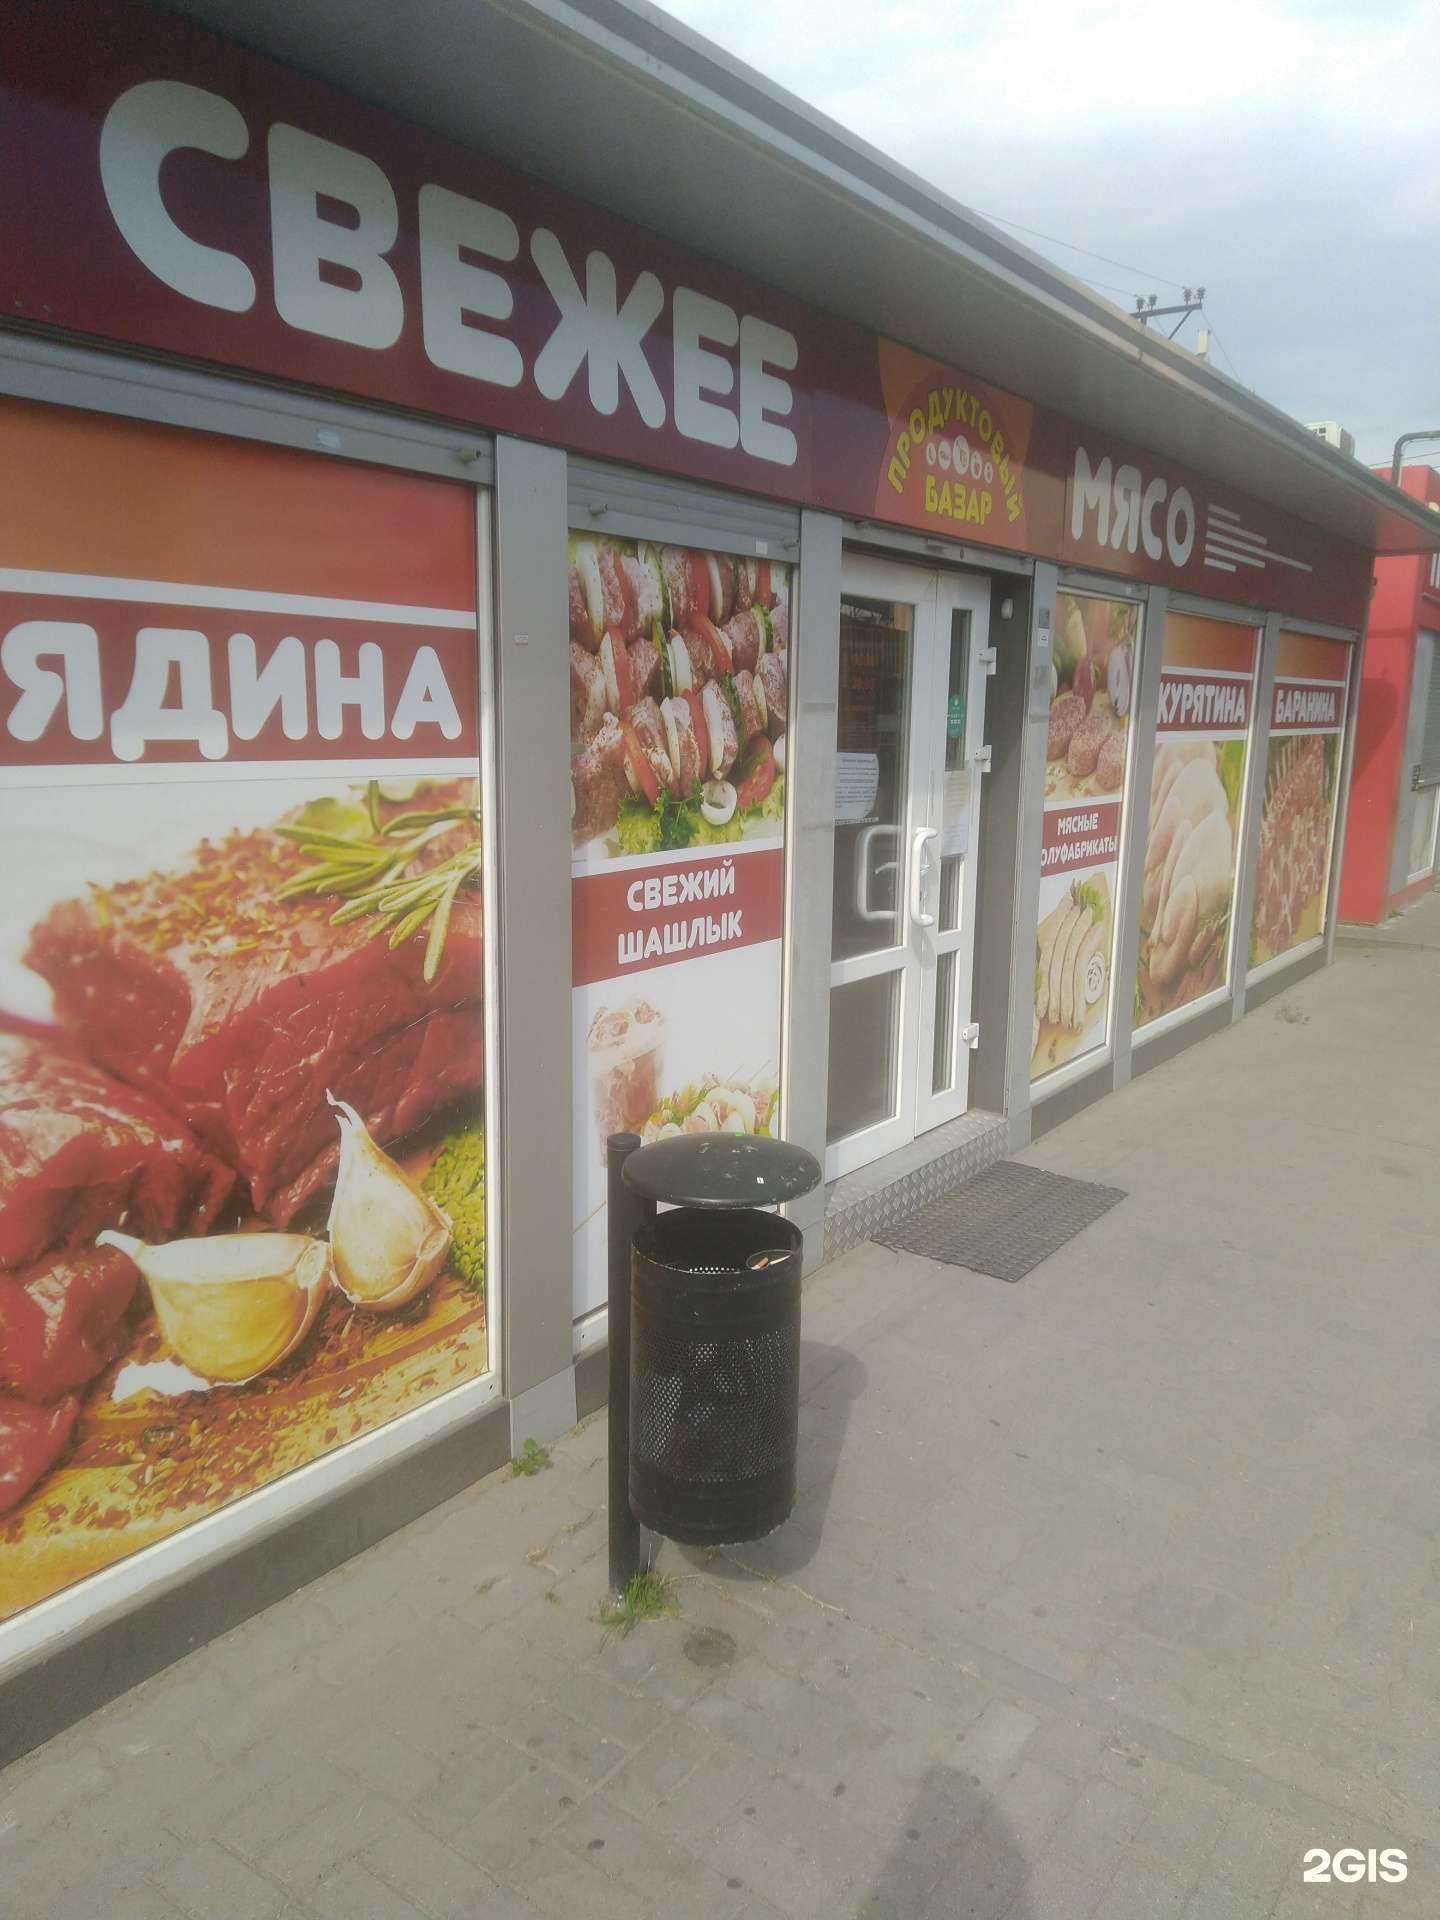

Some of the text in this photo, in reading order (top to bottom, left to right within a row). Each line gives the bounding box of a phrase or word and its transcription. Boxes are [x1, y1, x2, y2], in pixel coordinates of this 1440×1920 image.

[99, 79, 799, 466] СВЕЖЕЕ
[887, 387, 1024, 522] ПРОДУКТОВЫЙ
[925, 474, 993, 525] БАЗАР
[1071, 446, 1196, 567] МЯСО
[1157, 681, 1246, 724] КУРЯТИНА
[1275, 689, 1336, 724] БАРАНИНА
[1057, 812, 1099, 836] МЯСНЫЕ
[626, 858, 736, 912] СВЕЖИЙ
[617, 909, 743, 965] ШАШЛЫК
